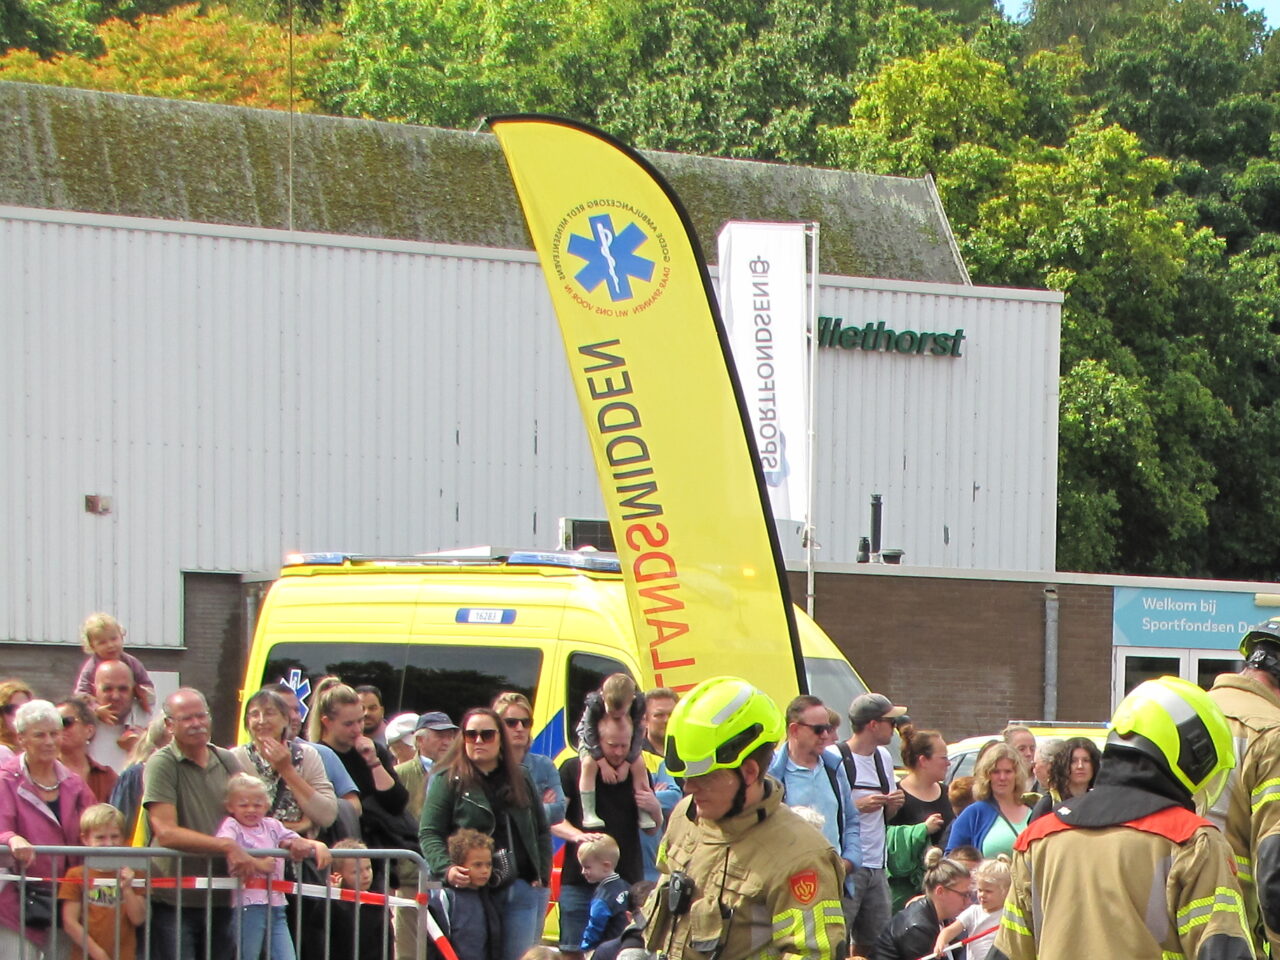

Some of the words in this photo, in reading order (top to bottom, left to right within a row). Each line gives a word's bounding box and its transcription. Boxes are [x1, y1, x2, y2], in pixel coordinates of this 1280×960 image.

[1142, 597, 1197, 612] Welkom
[1200, 599, 1217, 615] bij
[1142, 617, 1235, 633] Sportfondsen
